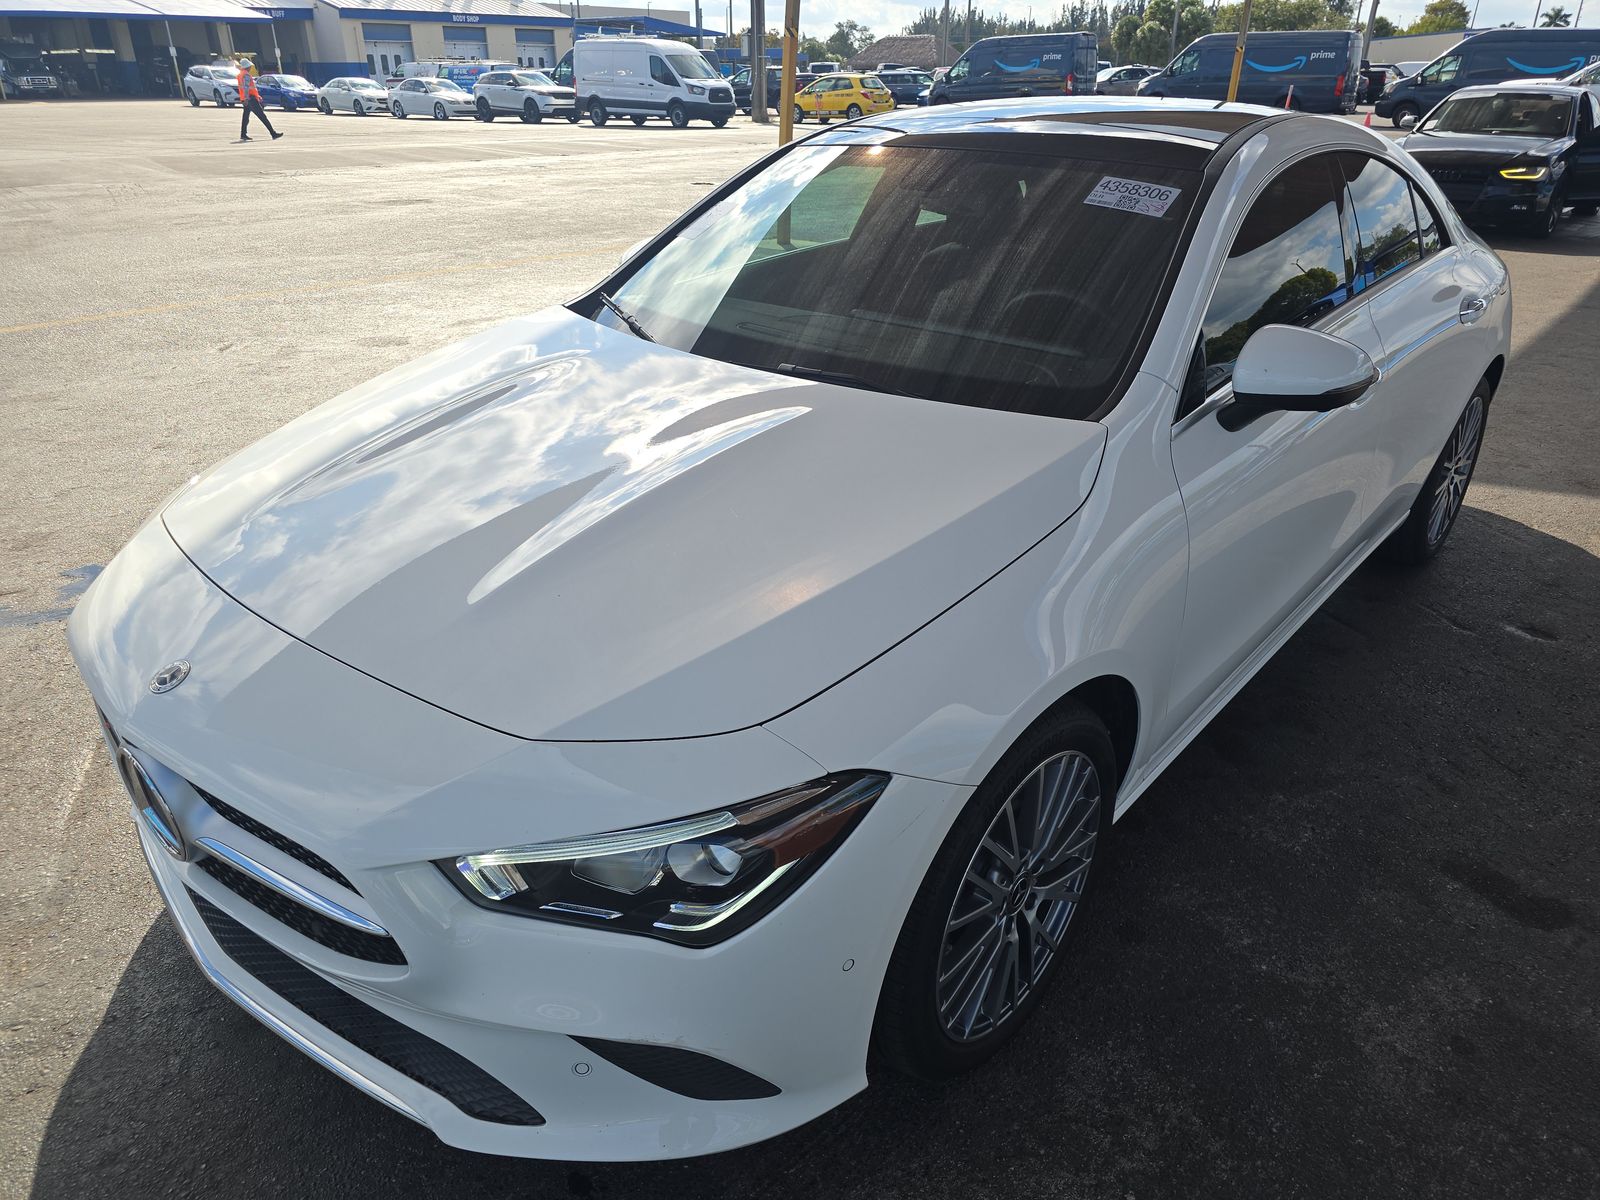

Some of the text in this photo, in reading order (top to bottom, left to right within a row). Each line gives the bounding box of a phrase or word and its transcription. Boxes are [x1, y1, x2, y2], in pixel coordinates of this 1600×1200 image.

[272, 10, 285, 18] BUFF
[452, 14, 480, 23] BODY SHOP
[1042, 52, 1062, 62] prime
[1310, 50, 1336, 61] prime
[1099, 179, 1172, 202] 4358306
